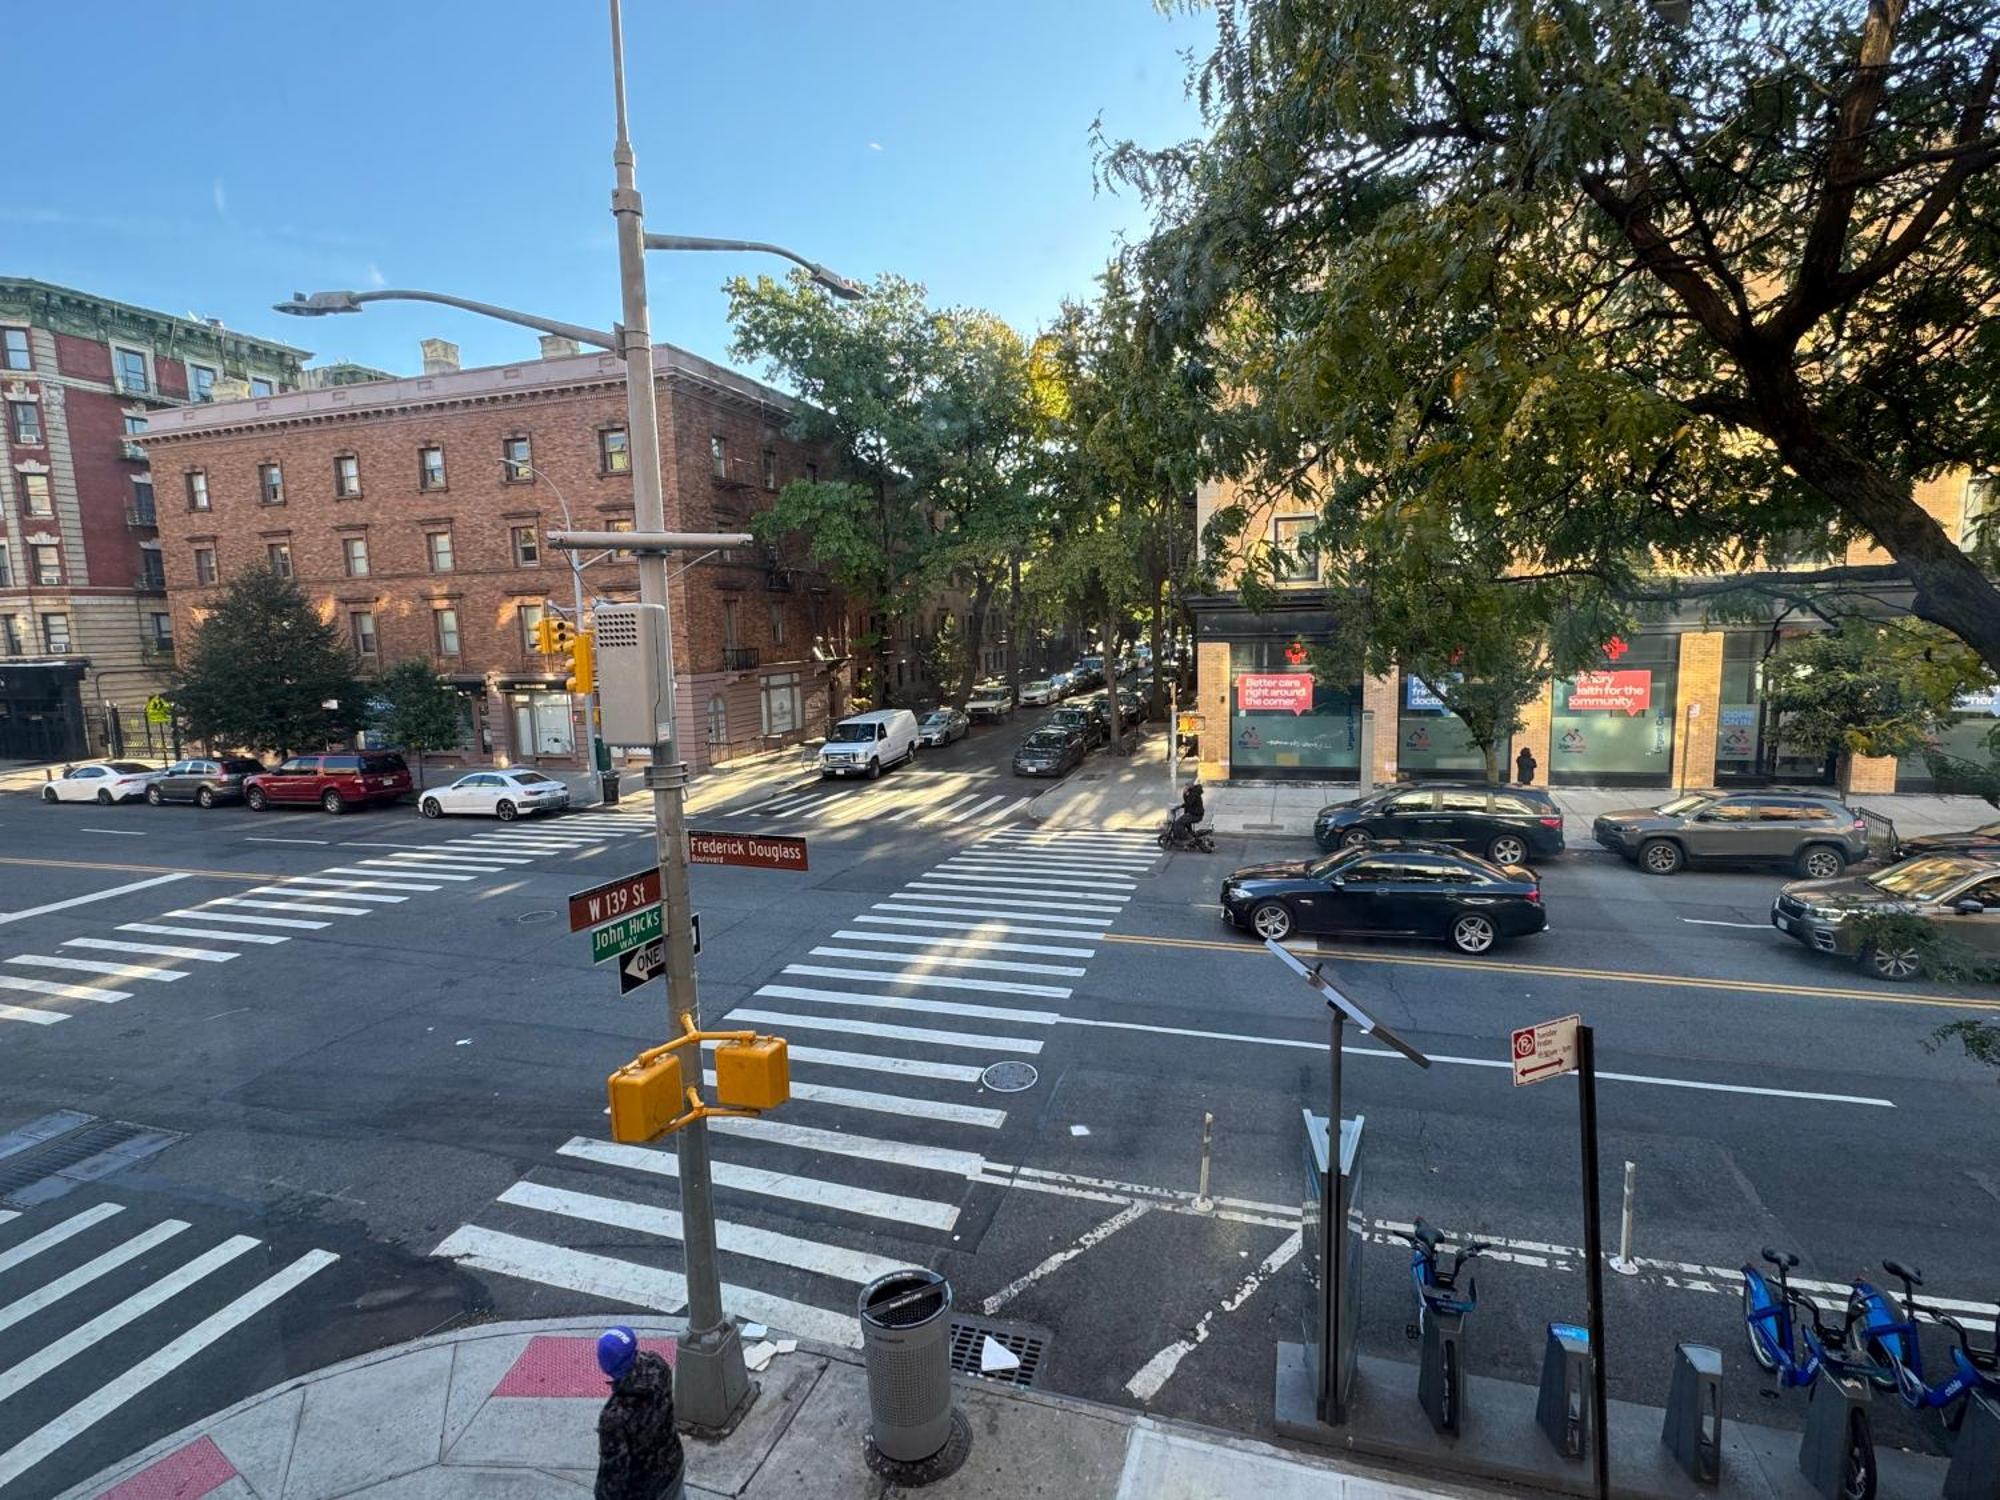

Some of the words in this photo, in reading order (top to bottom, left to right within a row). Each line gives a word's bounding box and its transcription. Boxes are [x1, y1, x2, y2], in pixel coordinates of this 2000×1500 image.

[1246, 678, 1276, 687] Better
[1279, 679, 1300, 687] care
[1246, 688, 1270, 698] right
[1271, 688, 1306, 697] around
[1604, 685, 1621, 696] for
[1624, 685, 1645, 696] the
[1263, 698, 1298, 706] corner.
[690, 837, 745, 855] Frederick
[749, 841, 801, 861] Douglass
[589, 898, 600, 921] W
[605, 889, 627, 916] 139
[632, 882, 646, 906] St
[595, 924, 625, 951] John
[629, 911, 660, 936] Hicks
[619, 935, 638, 950] WAY
[636, 947, 660, 971] ONE
